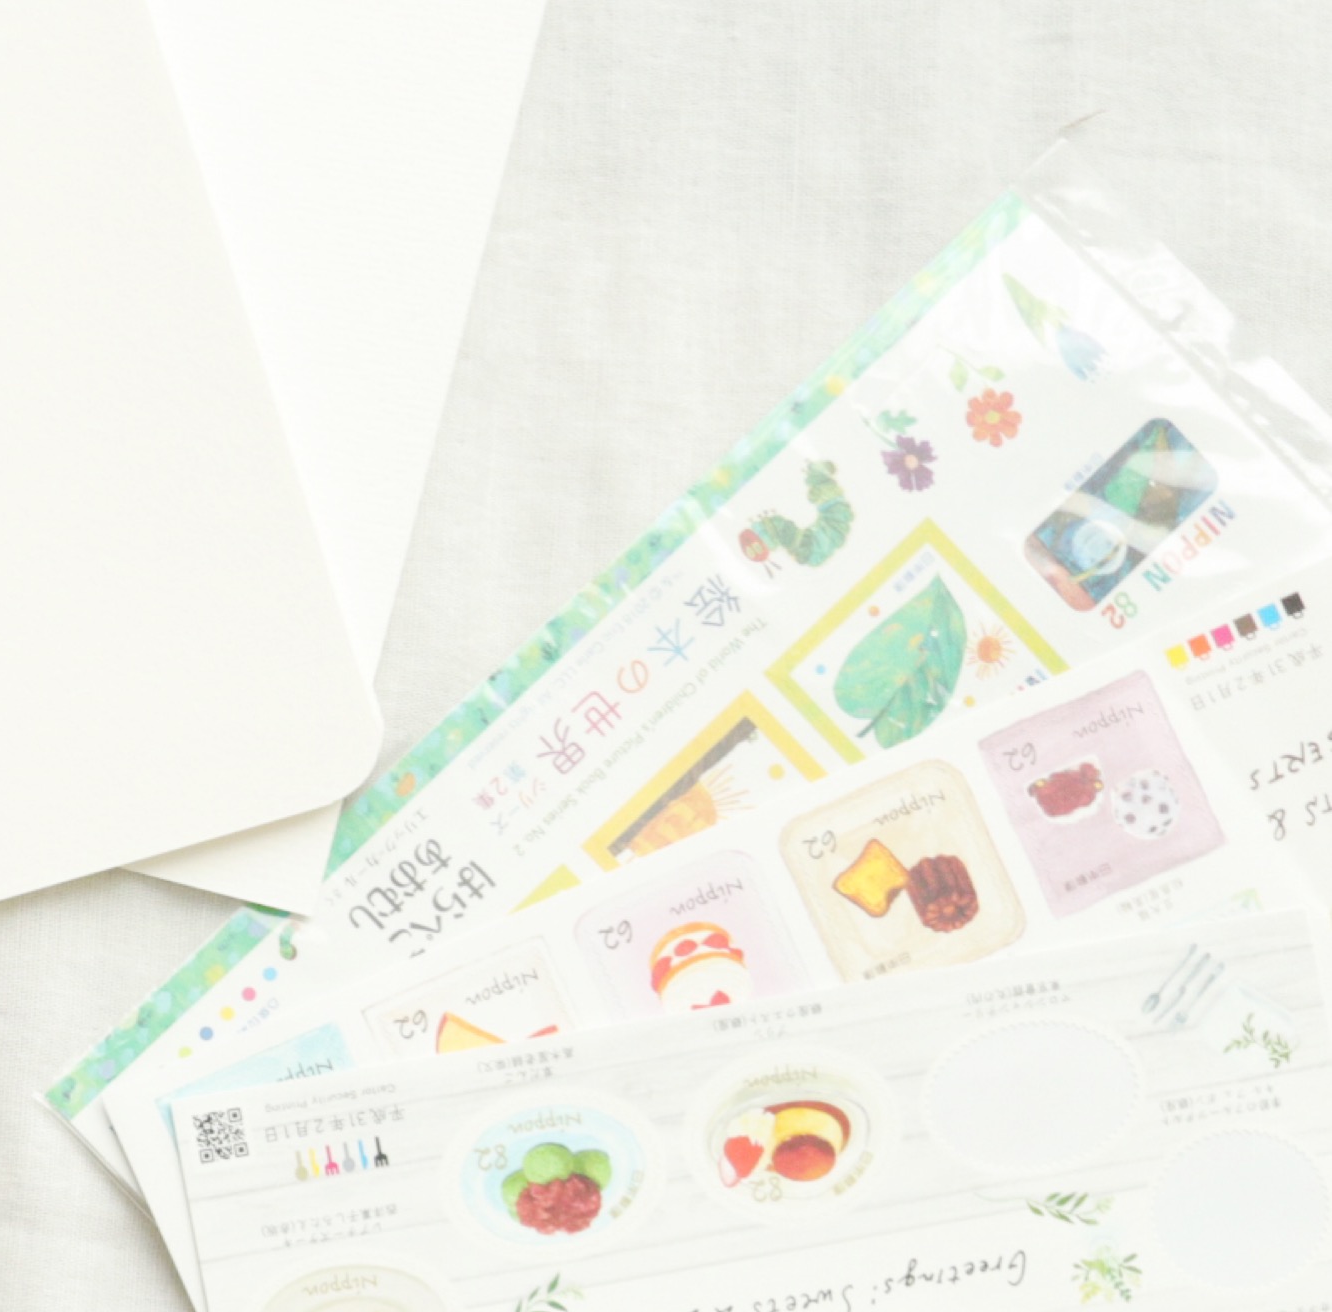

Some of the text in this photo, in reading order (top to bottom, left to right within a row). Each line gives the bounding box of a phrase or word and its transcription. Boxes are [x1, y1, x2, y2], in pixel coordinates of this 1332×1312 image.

[1101, 501, 1235, 630] NIPPON 82
[739, 614, 768, 642] The
[706, 635, 745, 672] World
[535, 575, 741, 774] 絵本の世界
[693, 666, 712, 685] of
[639, 679, 698, 735] Children's
[601, 730, 645, 772] Picture
[1001, 701, 1144, 775] Nippon 62
[574, 766, 607, 798] Book
[486, 775, 551, 837] シリーズ
[541, 793, 579, 829] Series
[1263, 806, 1295, 843] &
[800, 788, 946, 864] Nippon 62
[349, 835, 453, 930] あおむし
[388, 860, 497, 960] はらぺこ
[596, 877, 743, 953] Nippon 62
[392, 968, 538, 1042] Nippon 62
[744, 1064, 818, 1090] Nippon
[264, 1097, 307, 1114] Printing
[311, 1088, 357, 1106] Security
[262, 1102, 406, 1143] 平成31年2月1日
[506, 1112, 582, 1137] Nippon
[473, 1143, 509, 1173] 82
[748, 1174, 783, 1205] 82
[303, 1273, 377, 1298] Nippon
[870, 1250, 1027, 1305] Greetings:
